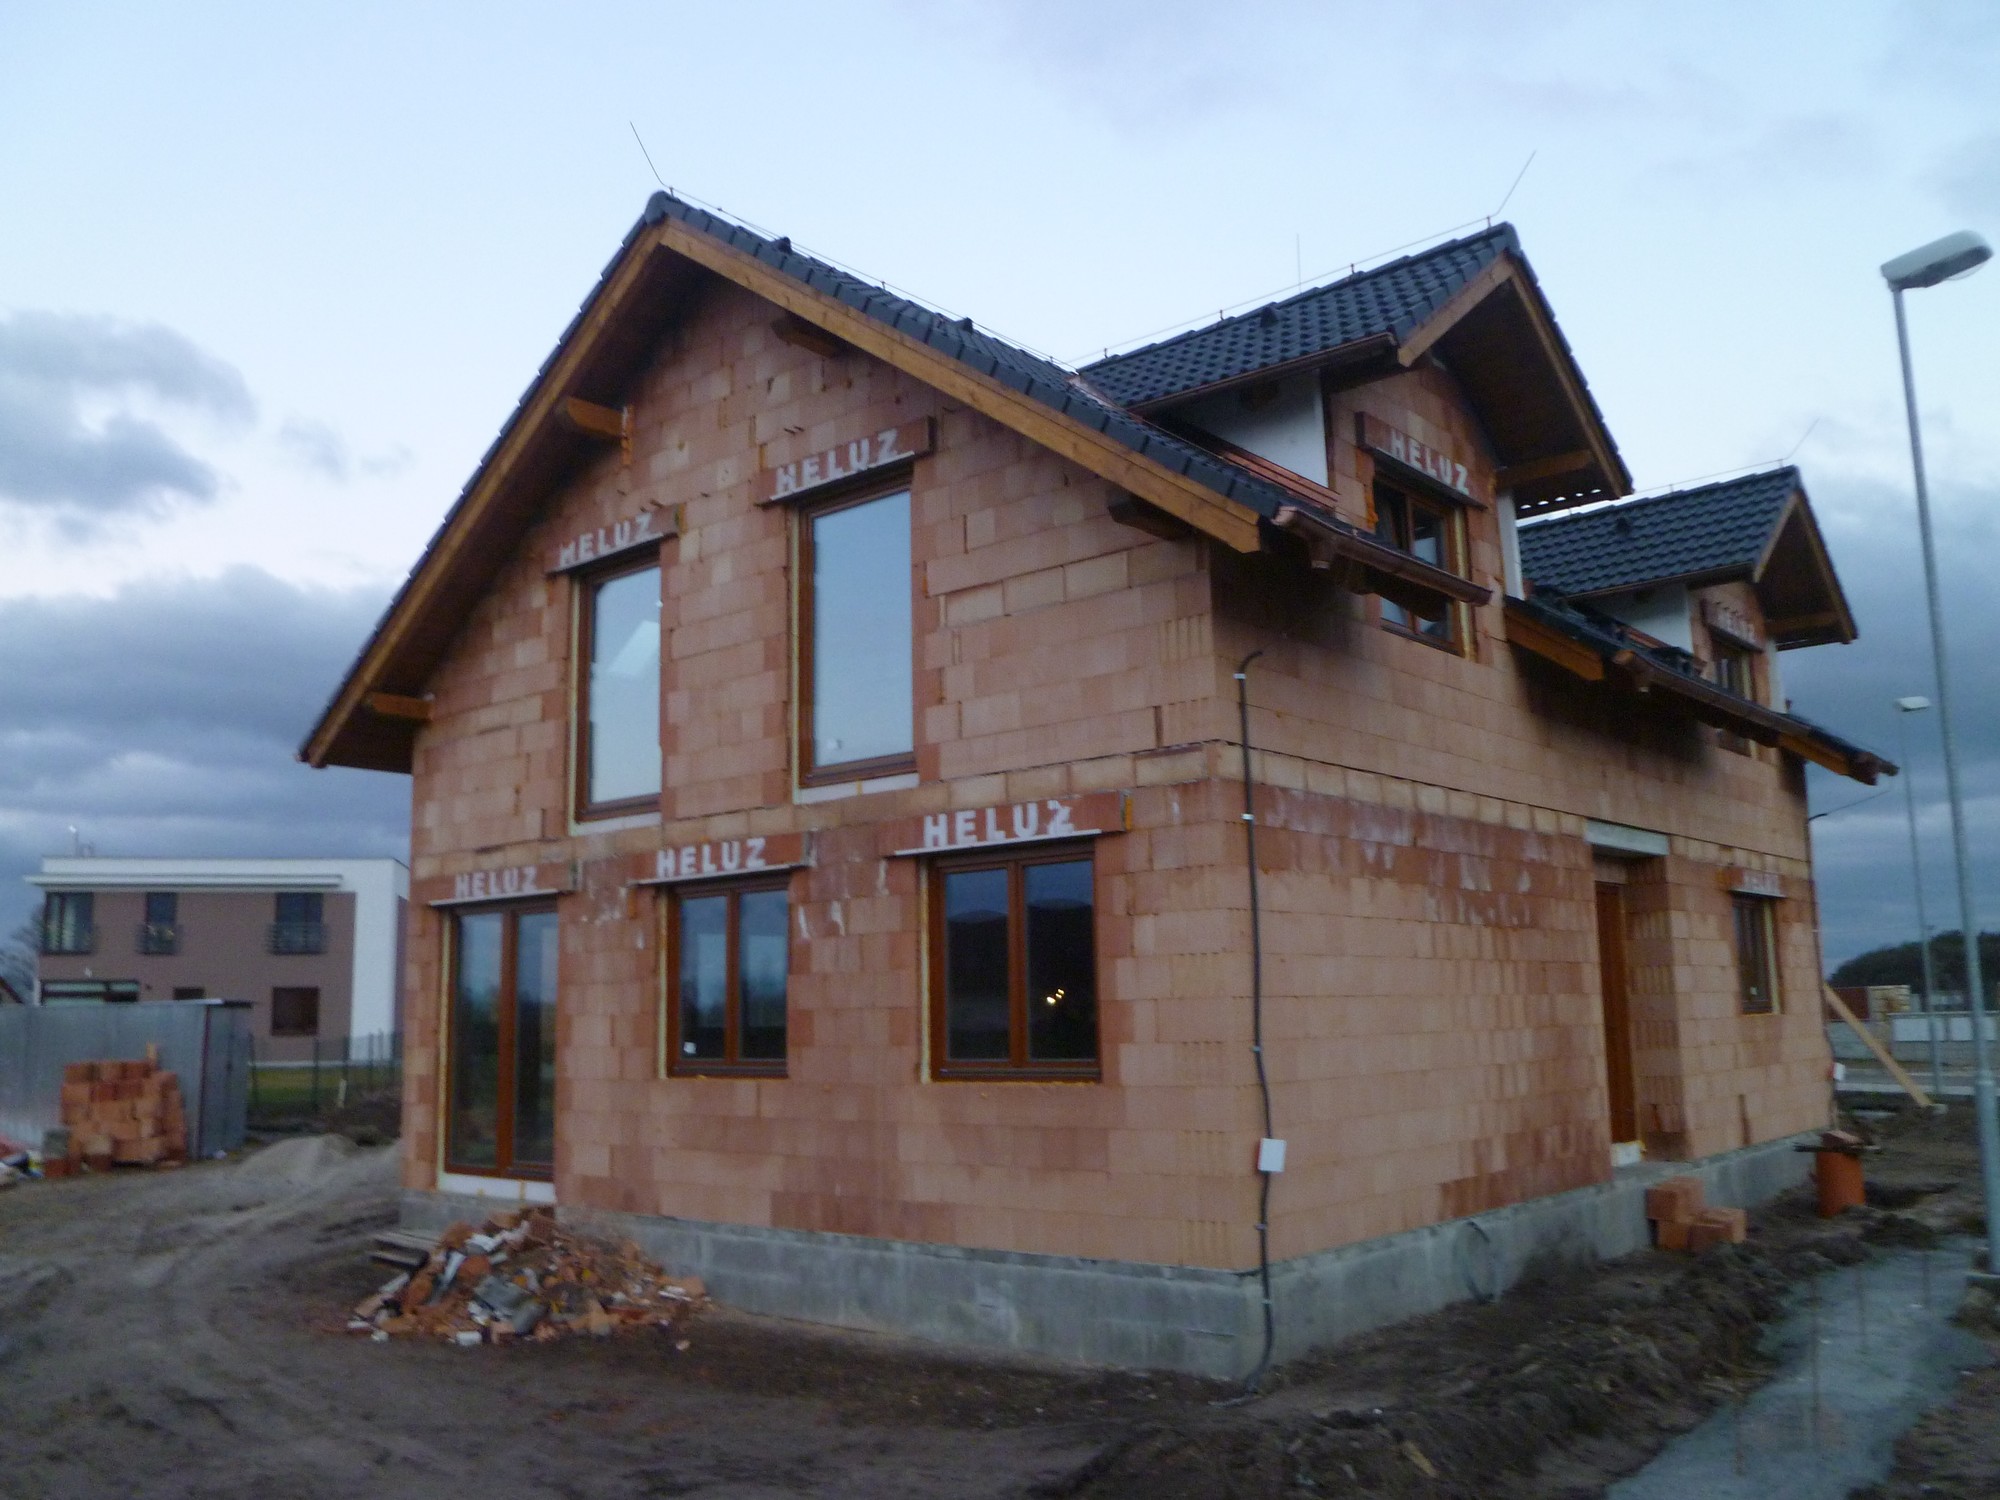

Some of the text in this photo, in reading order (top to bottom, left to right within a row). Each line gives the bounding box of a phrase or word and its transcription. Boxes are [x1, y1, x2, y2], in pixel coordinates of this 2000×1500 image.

[776, 428, 898, 496] HELUZ
[1391, 429, 1470, 496] HELUZ
[559, 512, 653, 567] HELUZ
[924, 800, 1074, 848] HELUZ
[455, 865, 537, 899] HELUZ
[656, 837, 766, 879] HELUZ
